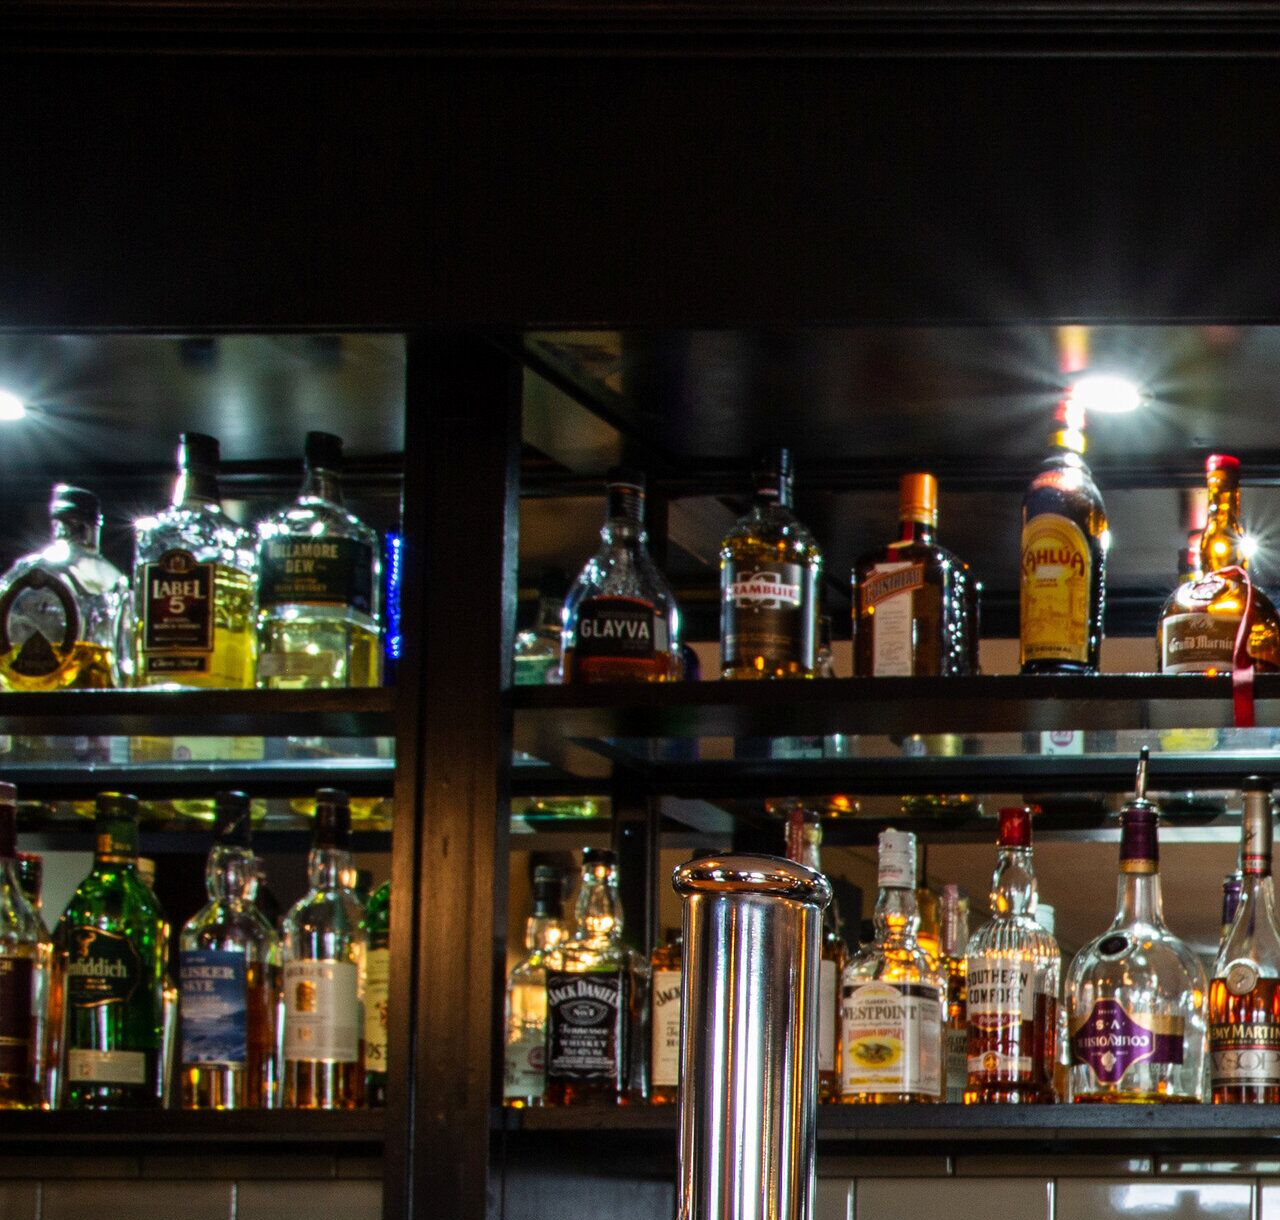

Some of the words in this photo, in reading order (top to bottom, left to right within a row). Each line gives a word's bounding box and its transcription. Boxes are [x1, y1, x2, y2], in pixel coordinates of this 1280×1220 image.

[285, 560, 314, 573] DEW
[152, 579, 207, 600] LABEL
[168, 599, 185, 614] 5
[580, 618, 649, 639] GLAYVA
[968, 969, 1028, 987] SOUTHERN
[549, 985, 577, 1007] JACK
[969, 988, 1023, 1004] COMFORT
[842, 1005, 917, 1021] WESTPOINT
